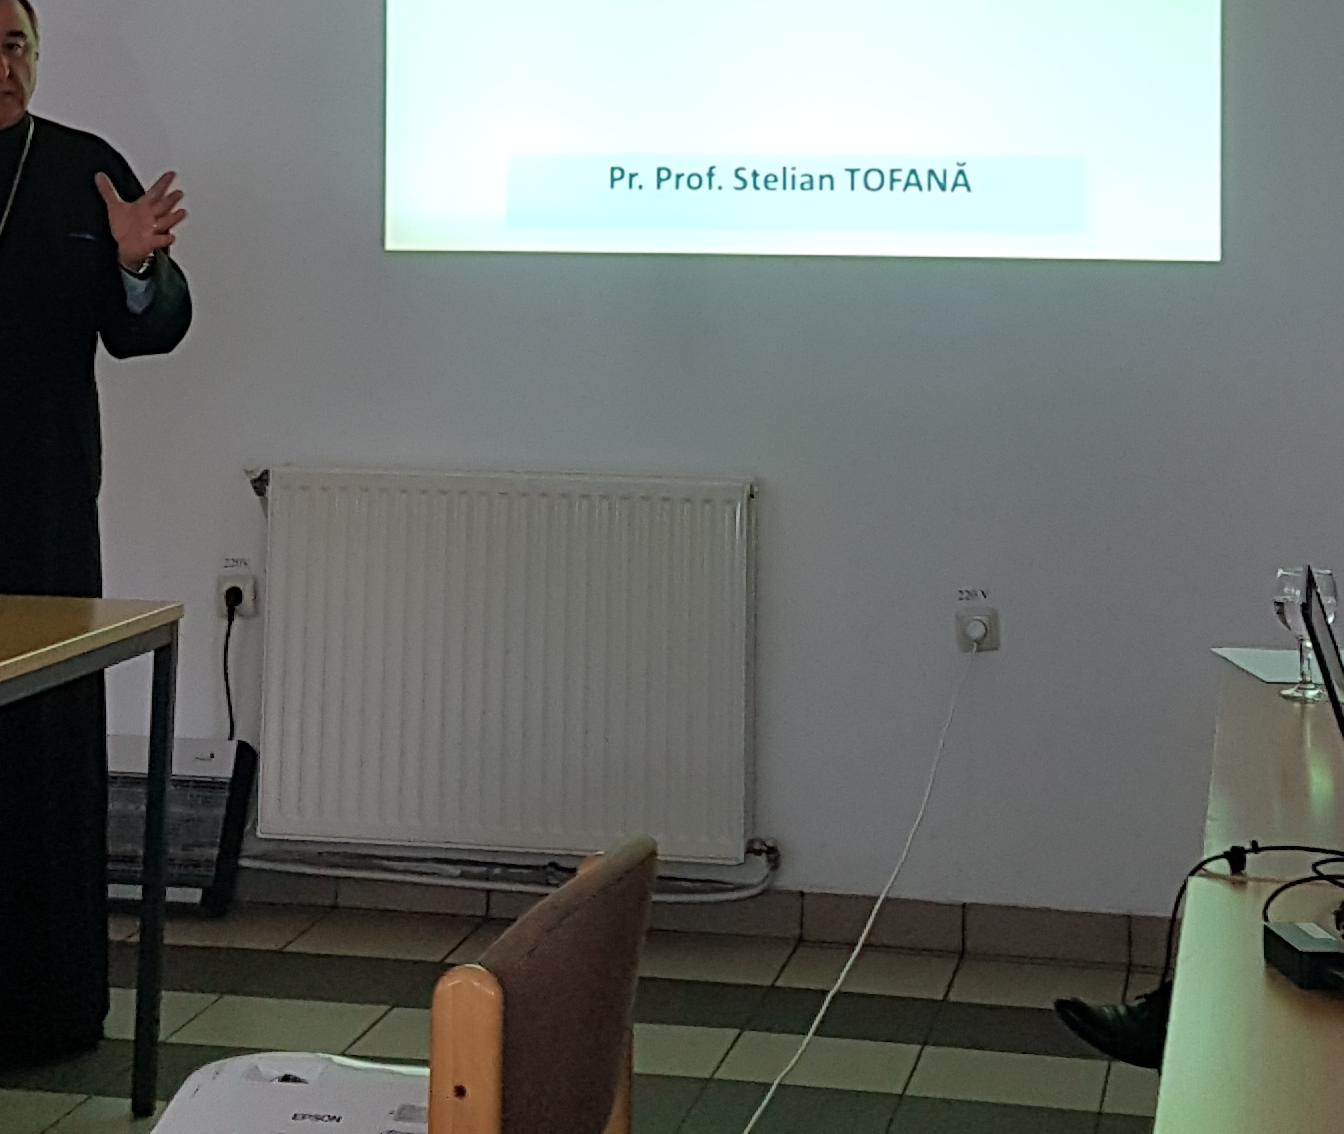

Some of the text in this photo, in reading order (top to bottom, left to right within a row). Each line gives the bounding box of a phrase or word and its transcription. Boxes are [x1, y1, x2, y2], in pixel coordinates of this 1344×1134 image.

[609, 162, 972, 193] Pr. Prof. Stelian TOFANĂ
